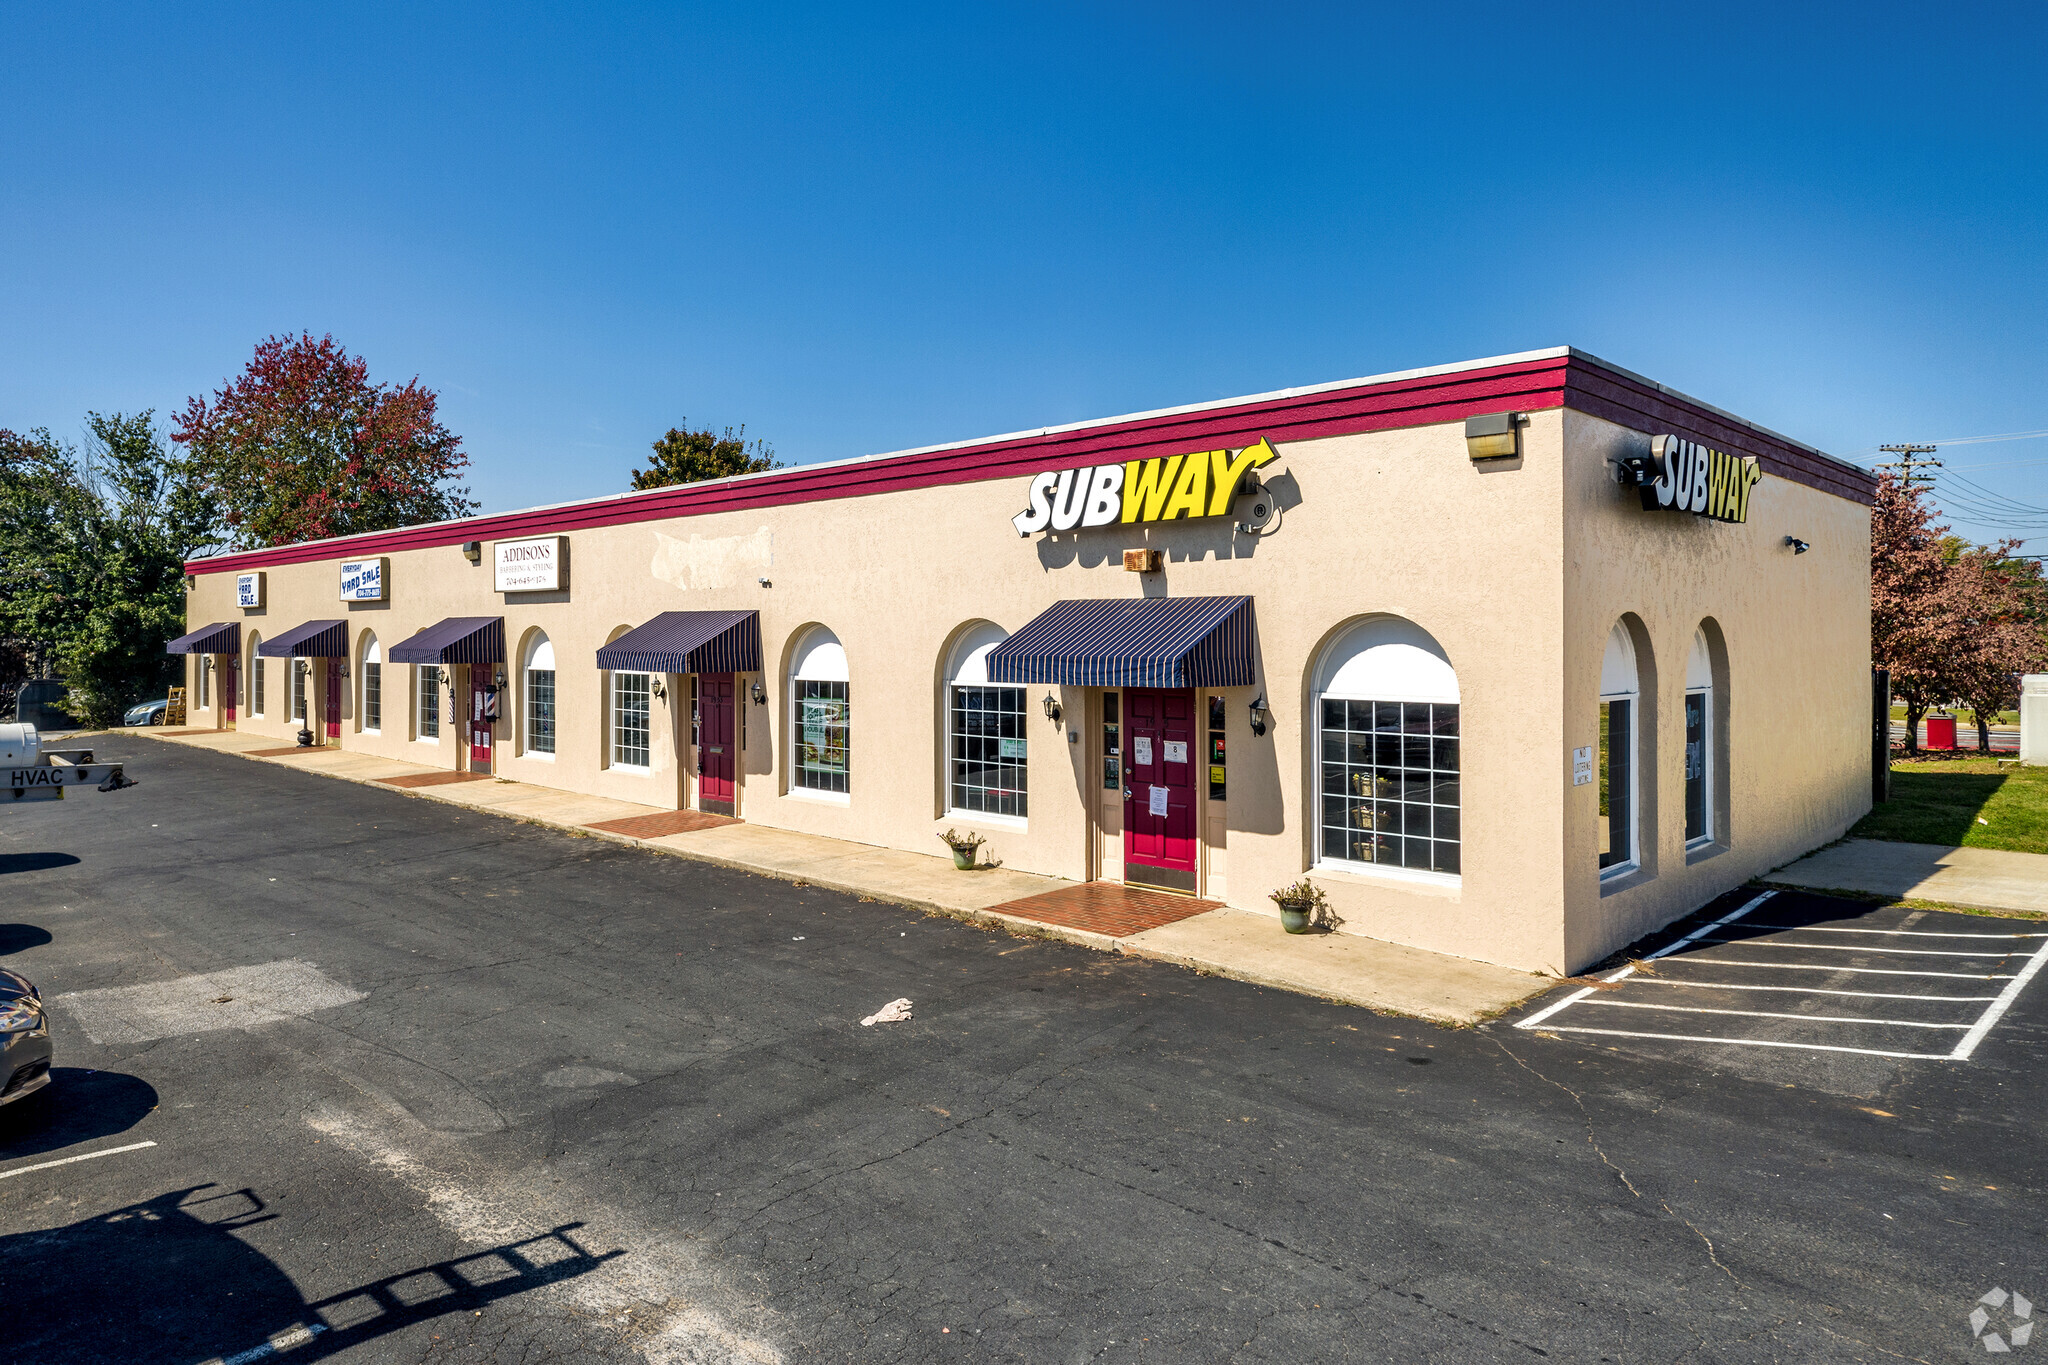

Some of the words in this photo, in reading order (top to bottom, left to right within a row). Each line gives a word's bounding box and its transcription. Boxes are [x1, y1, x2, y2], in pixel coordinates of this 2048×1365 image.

[1654, 433, 1761, 523] SUBWAY
[1011, 436, 1277, 538] SUBWAY
[503, 545, 550, 562] ADDISONS
[342, 564, 362, 573] EVERYDAY
[342, 576, 360, 594] YARD
[362, 566, 380, 585] SALE
[239, 584, 251, 595] YARD
[241, 595, 254, 605] SALE
[11, 768, 63, 786] HVAC
